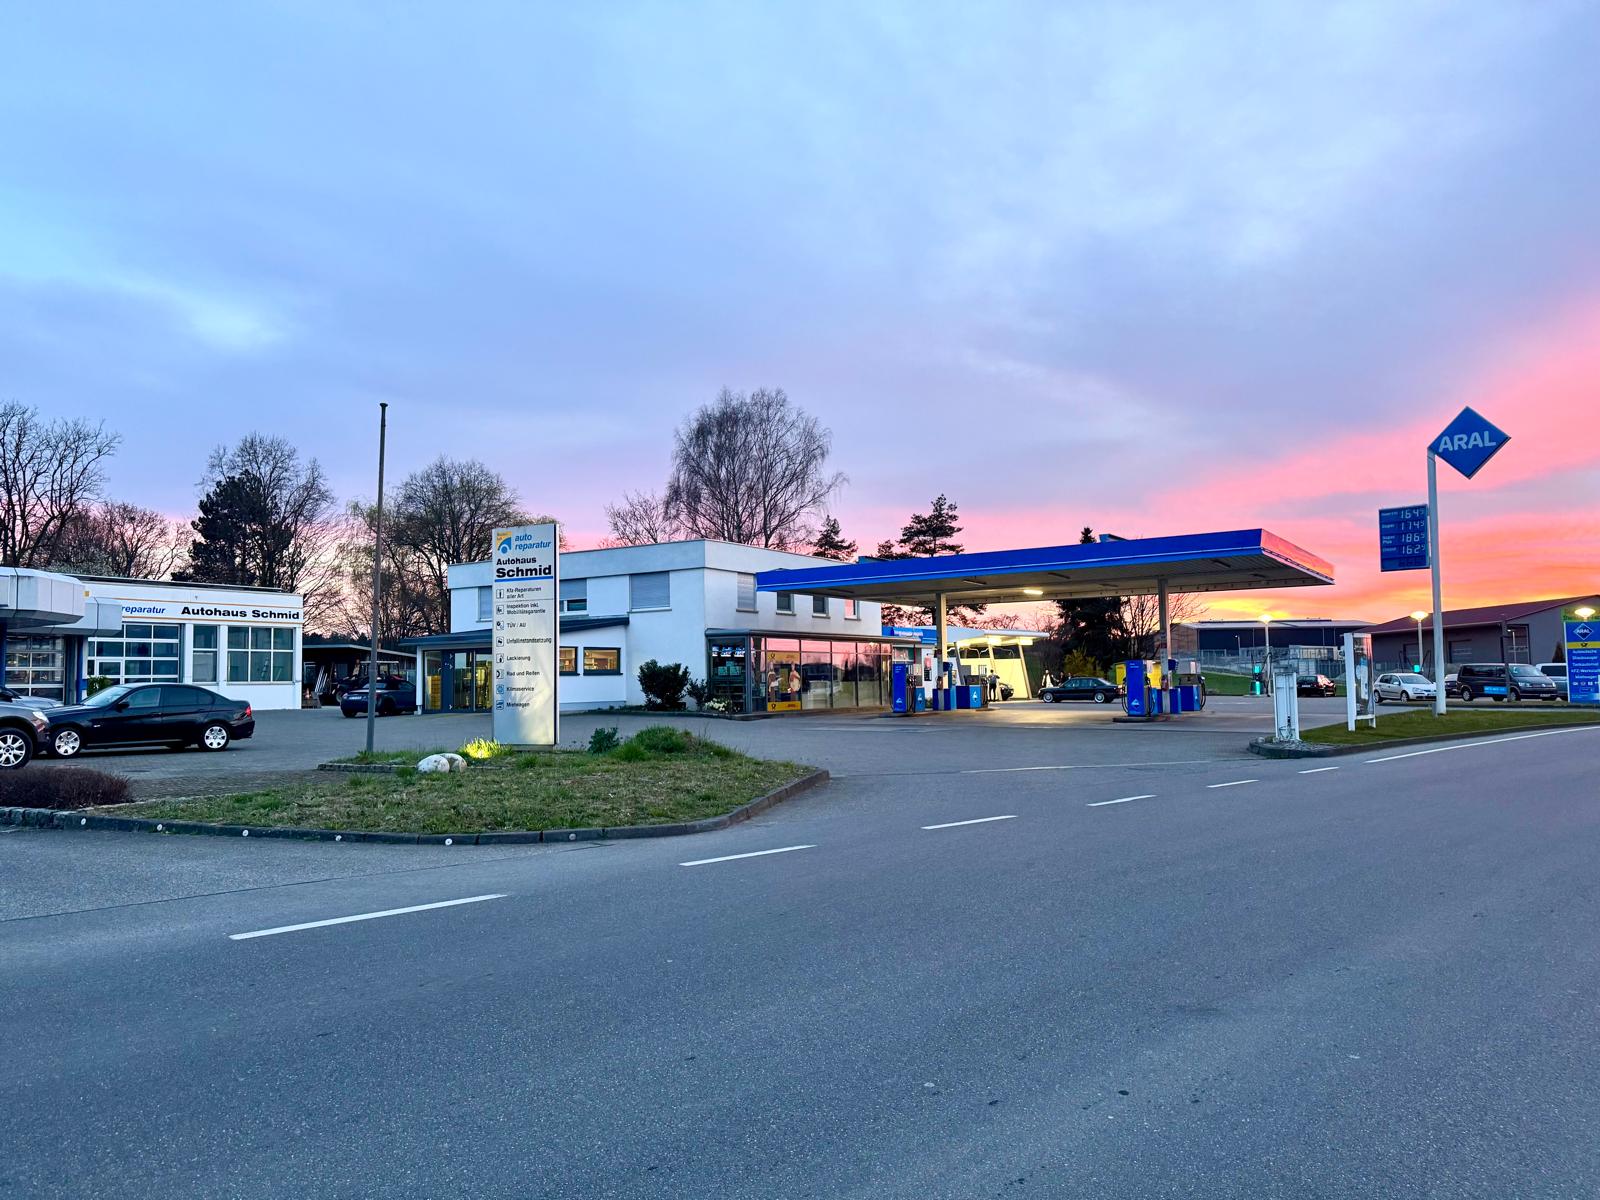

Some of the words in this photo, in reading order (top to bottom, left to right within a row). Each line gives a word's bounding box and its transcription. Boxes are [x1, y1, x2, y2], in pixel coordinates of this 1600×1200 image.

[1438, 430, 1497, 453] ARAL
[514, 533, 533, 542] auto
[514, 540, 552, 552] reparatur
[496, 557, 537, 566] Autohaus
[495, 564, 552, 578] Schmid
[506, 602, 530, 610] Inspektion
[122, 606, 166, 615] reparatur
[181, 606, 248, 618] Autohaus
[251, 609, 300, 620] Schmid
